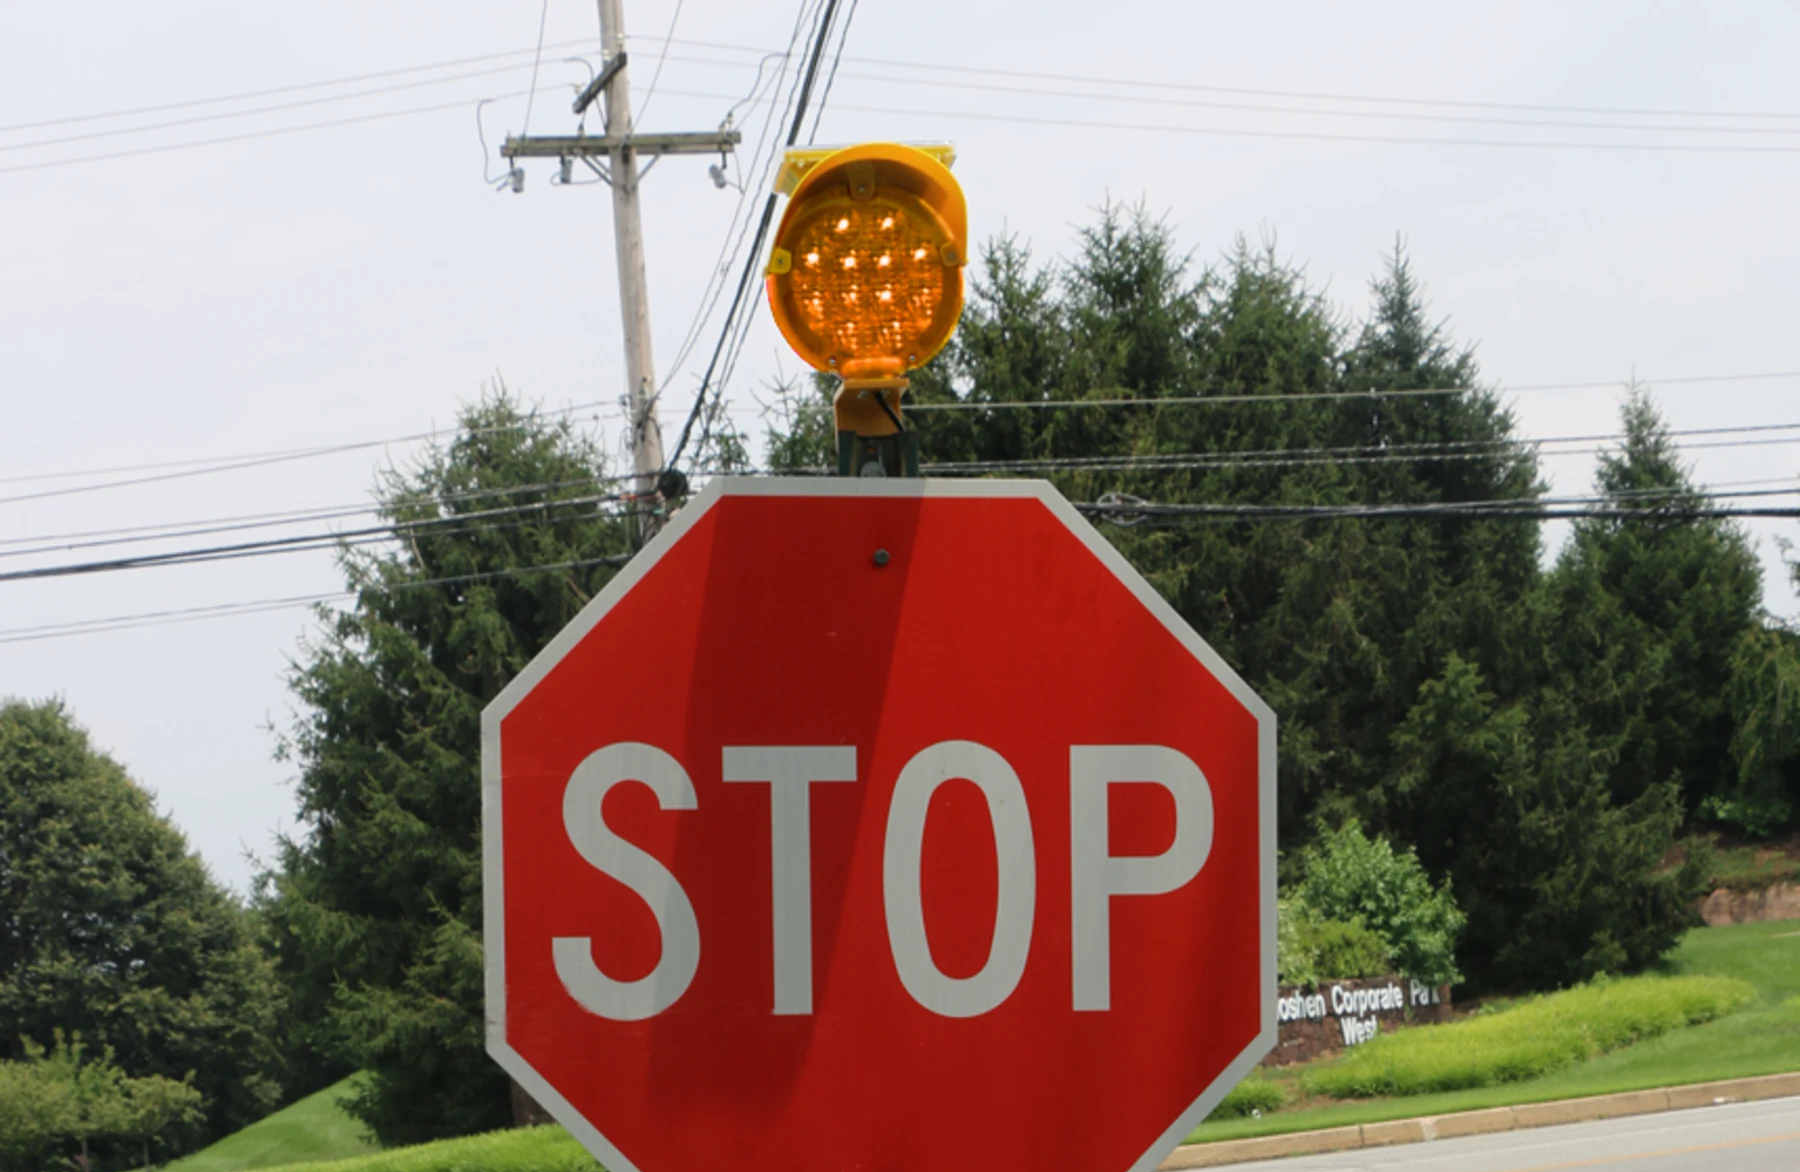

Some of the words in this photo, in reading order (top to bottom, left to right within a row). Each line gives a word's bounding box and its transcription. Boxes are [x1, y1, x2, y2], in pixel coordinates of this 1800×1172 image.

[551, 739, 1215, 1022] STOP
[1277, 989, 1326, 1020] oshen
[1331, 982, 1403, 1017] Corporate
[1410, 979, 1440, 1006] Pak
[1341, 1014, 1377, 1045] West
